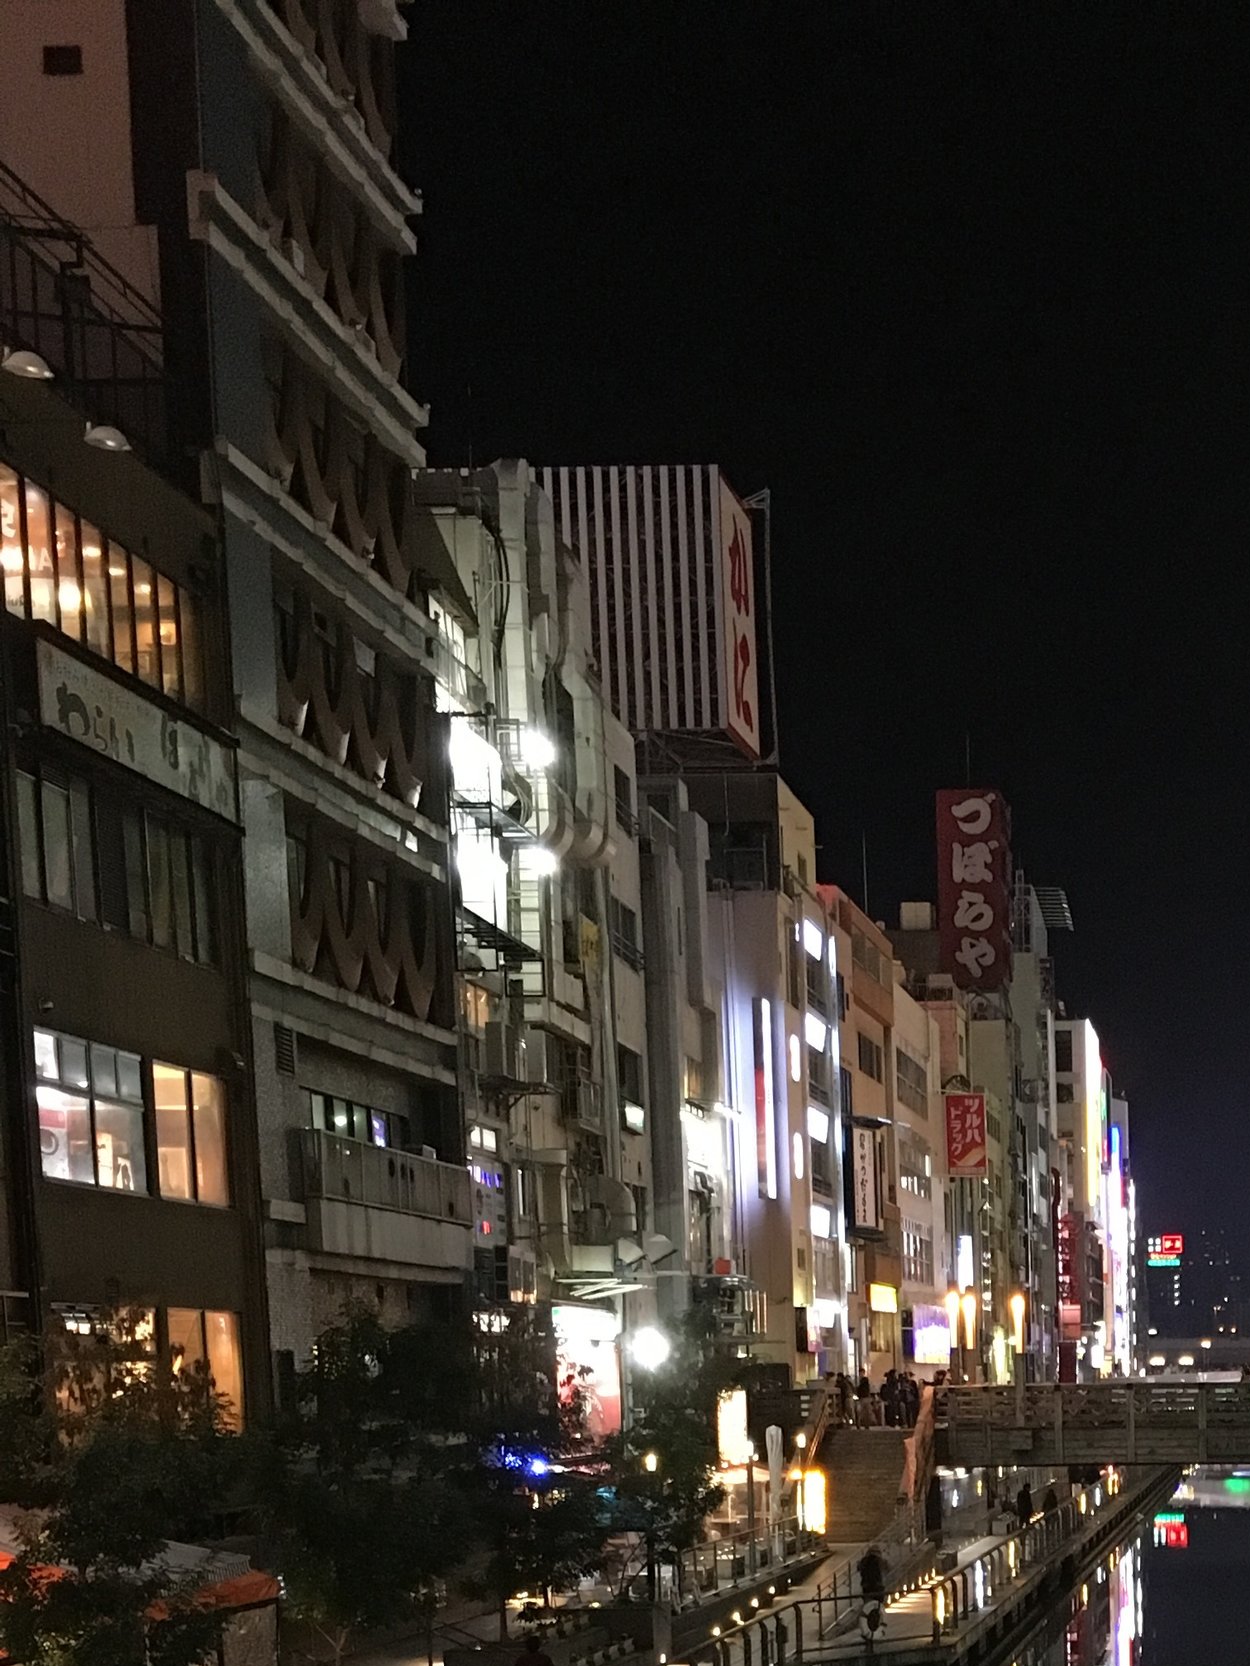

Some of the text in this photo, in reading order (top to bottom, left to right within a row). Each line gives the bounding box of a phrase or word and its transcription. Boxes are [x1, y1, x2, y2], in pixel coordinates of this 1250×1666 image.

[951, 792, 1000, 979] づぼらや
[949, 1106, 964, 1156] ドラッグ
[964, 1098, 982, 1143] ツルハ
